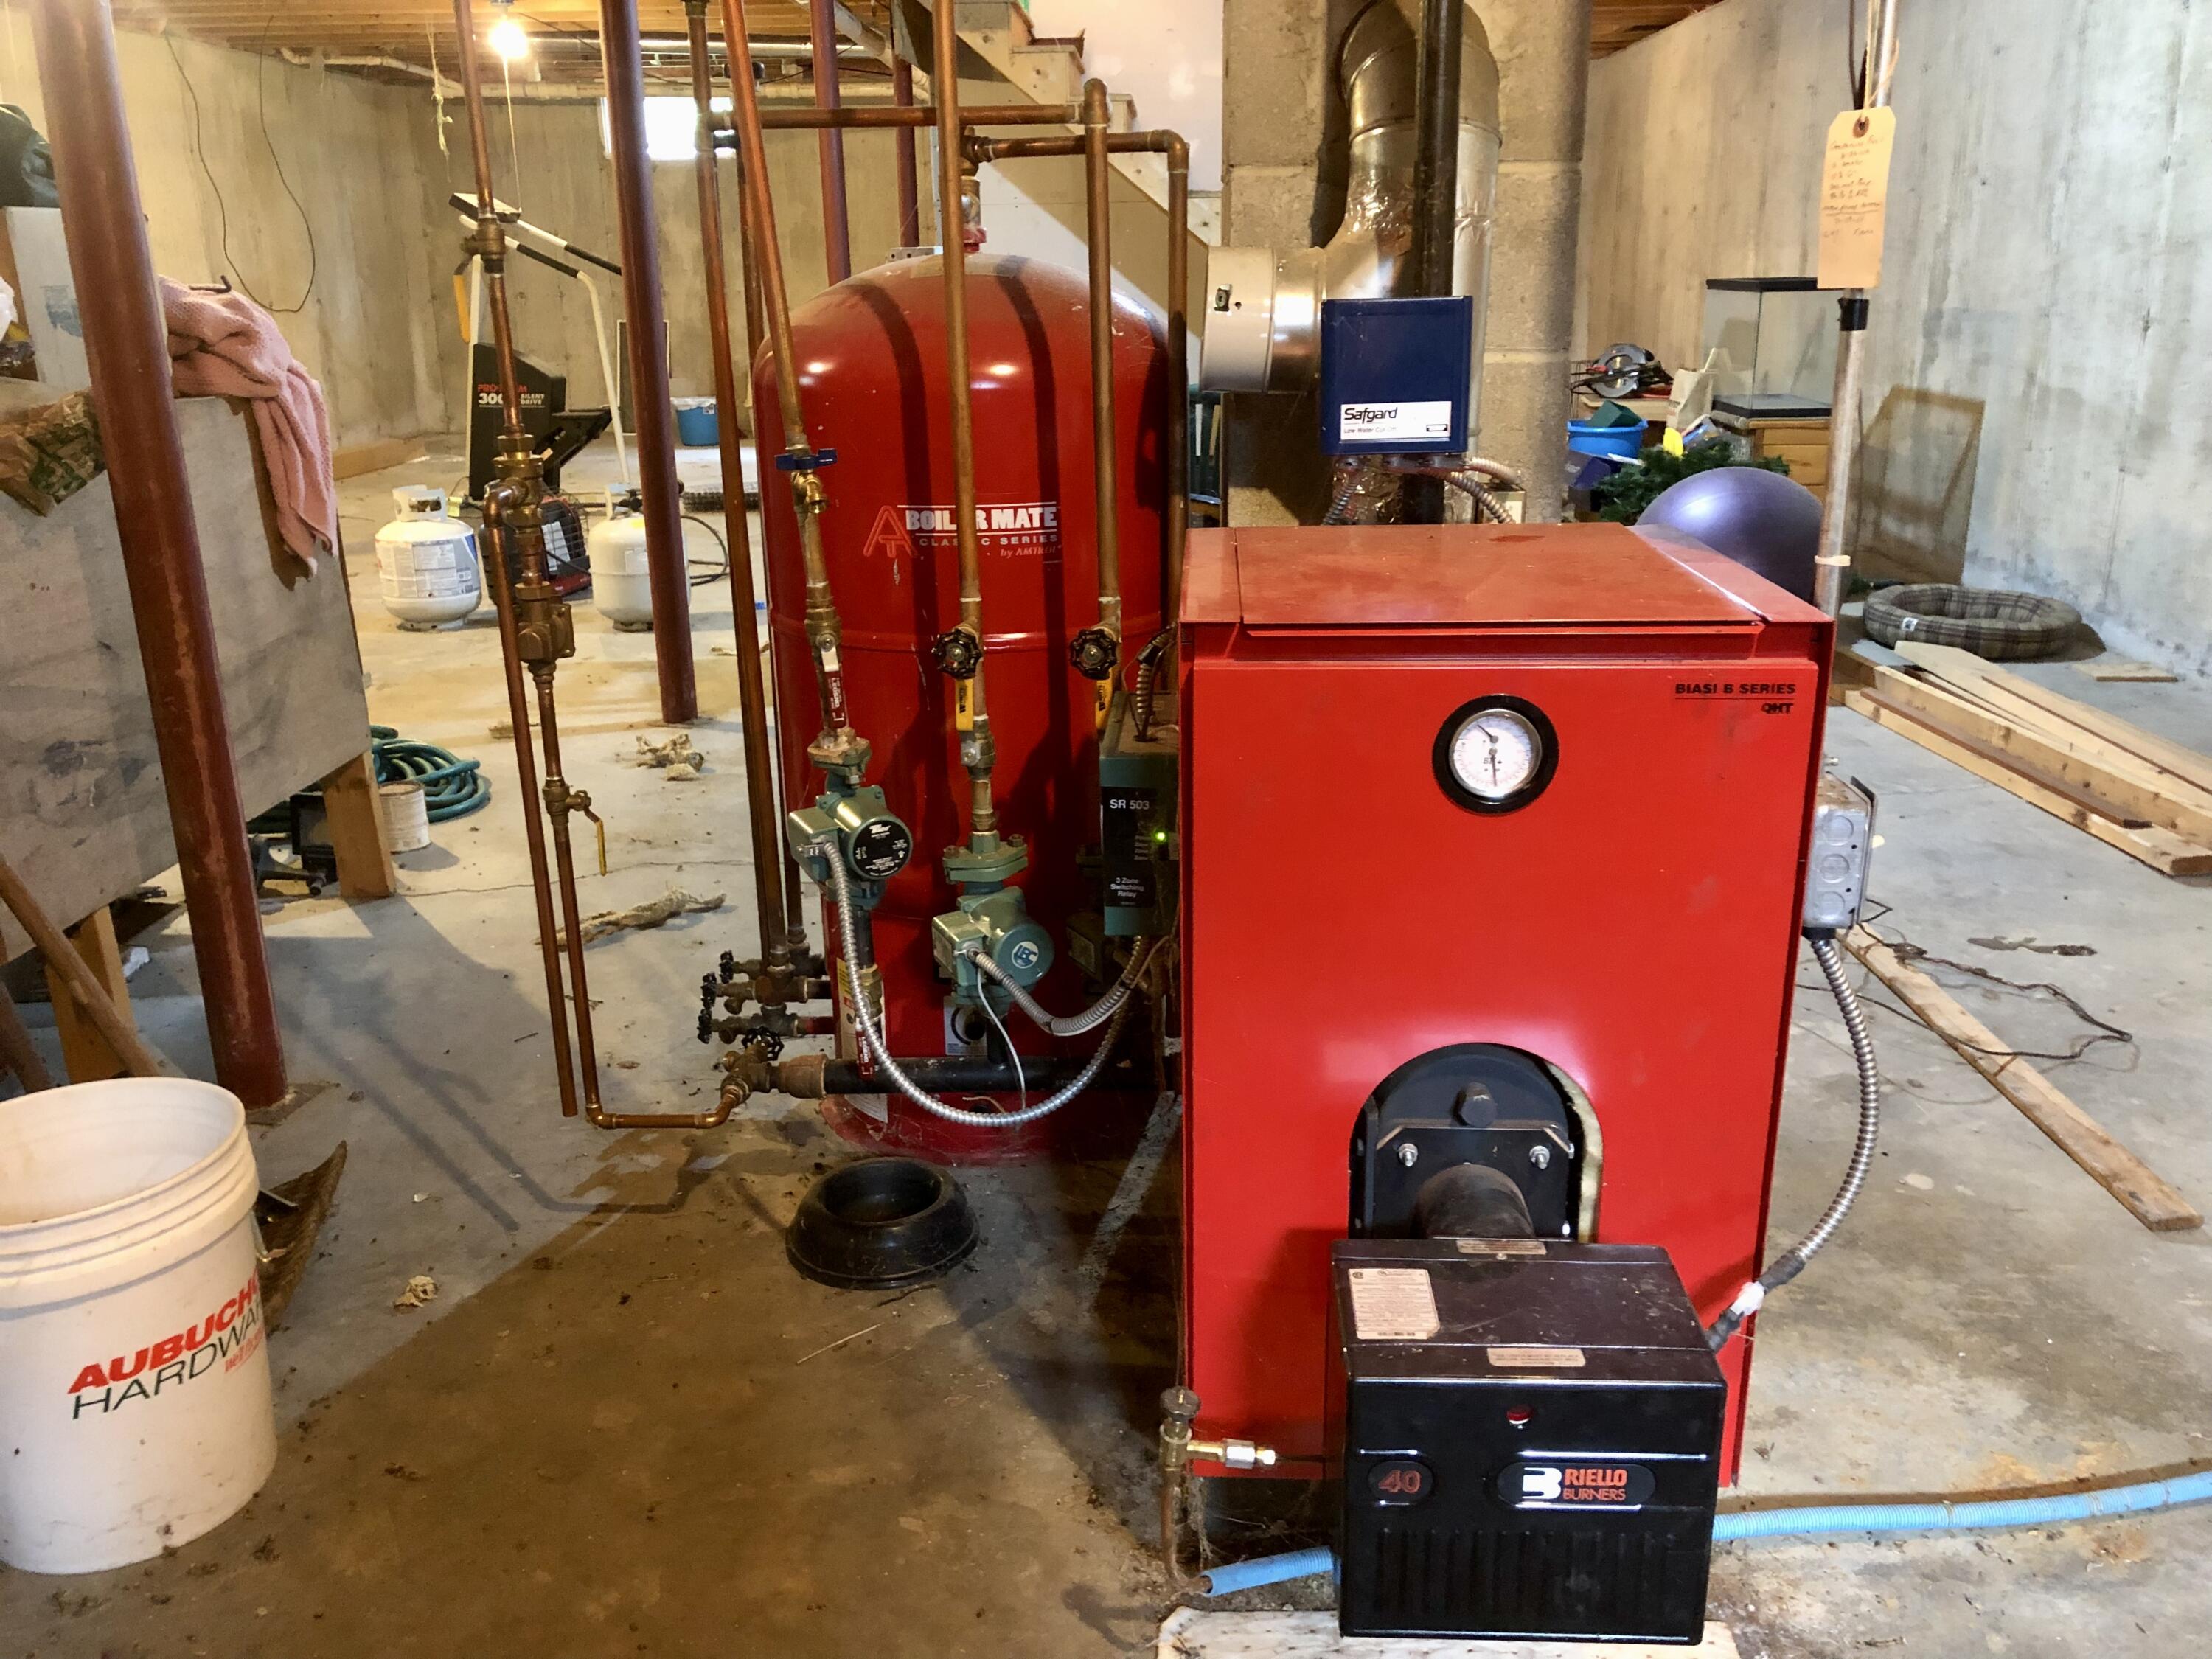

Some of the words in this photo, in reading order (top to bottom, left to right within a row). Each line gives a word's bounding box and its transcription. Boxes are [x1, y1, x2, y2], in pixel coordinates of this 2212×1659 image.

[478, 384, 527, 392] PRO-M
[1344, 407, 1398, 424] Safgard
[905, 509, 988, 531] BOILR
[991, 506, 1057, 529] MATE
[919, 537, 990, 546] CLASC
[1000, 535, 1057, 546] SERIES
[1001, 548, 1013, 558] by
[1675, 683, 1717, 694] BIASI
[1723, 684, 1734, 694] B
[1739, 684, 1796, 694] SERIES
[1110, 799, 1127, 809] SR
[1129, 800, 1150, 810] 503
[1110, 883, 1144, 892] Switching
[1117, 890, 1137, 898] Relay
[1377, 1470, 1422, 1494] 40
[1564, 1468, 1628, 1486] RIELLO
[1562, 1487, 1627, 1502] BURNERS
